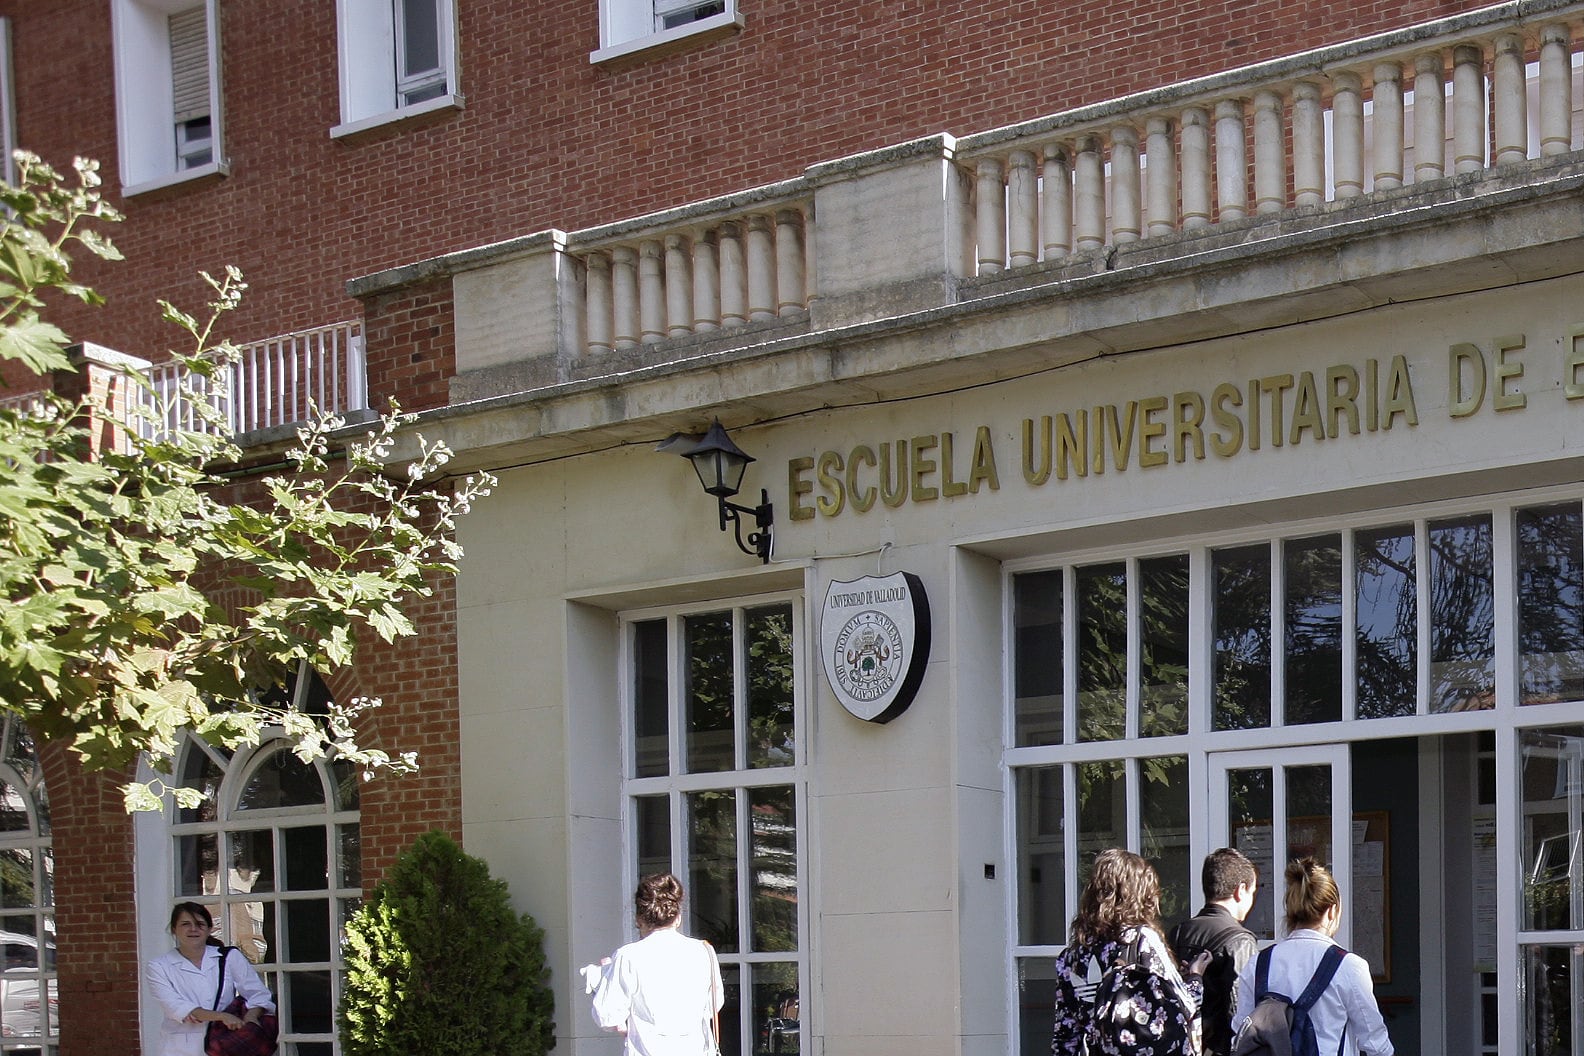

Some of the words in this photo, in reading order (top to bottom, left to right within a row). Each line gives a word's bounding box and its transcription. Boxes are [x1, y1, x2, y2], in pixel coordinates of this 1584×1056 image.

[788, 425, 1000, 522] ESCUELA
[1021, 353, 1419, 487] UNIVERSITARIA
[1448, 334, 1527, 418] DE
[830, 591, 865, 609] UNIVERSIDAD
[866, 591, 874, 605] DE
[873, 586, 906, 604] VALLADOLID
[874, 614, 901, 660] SAPIENTIA
